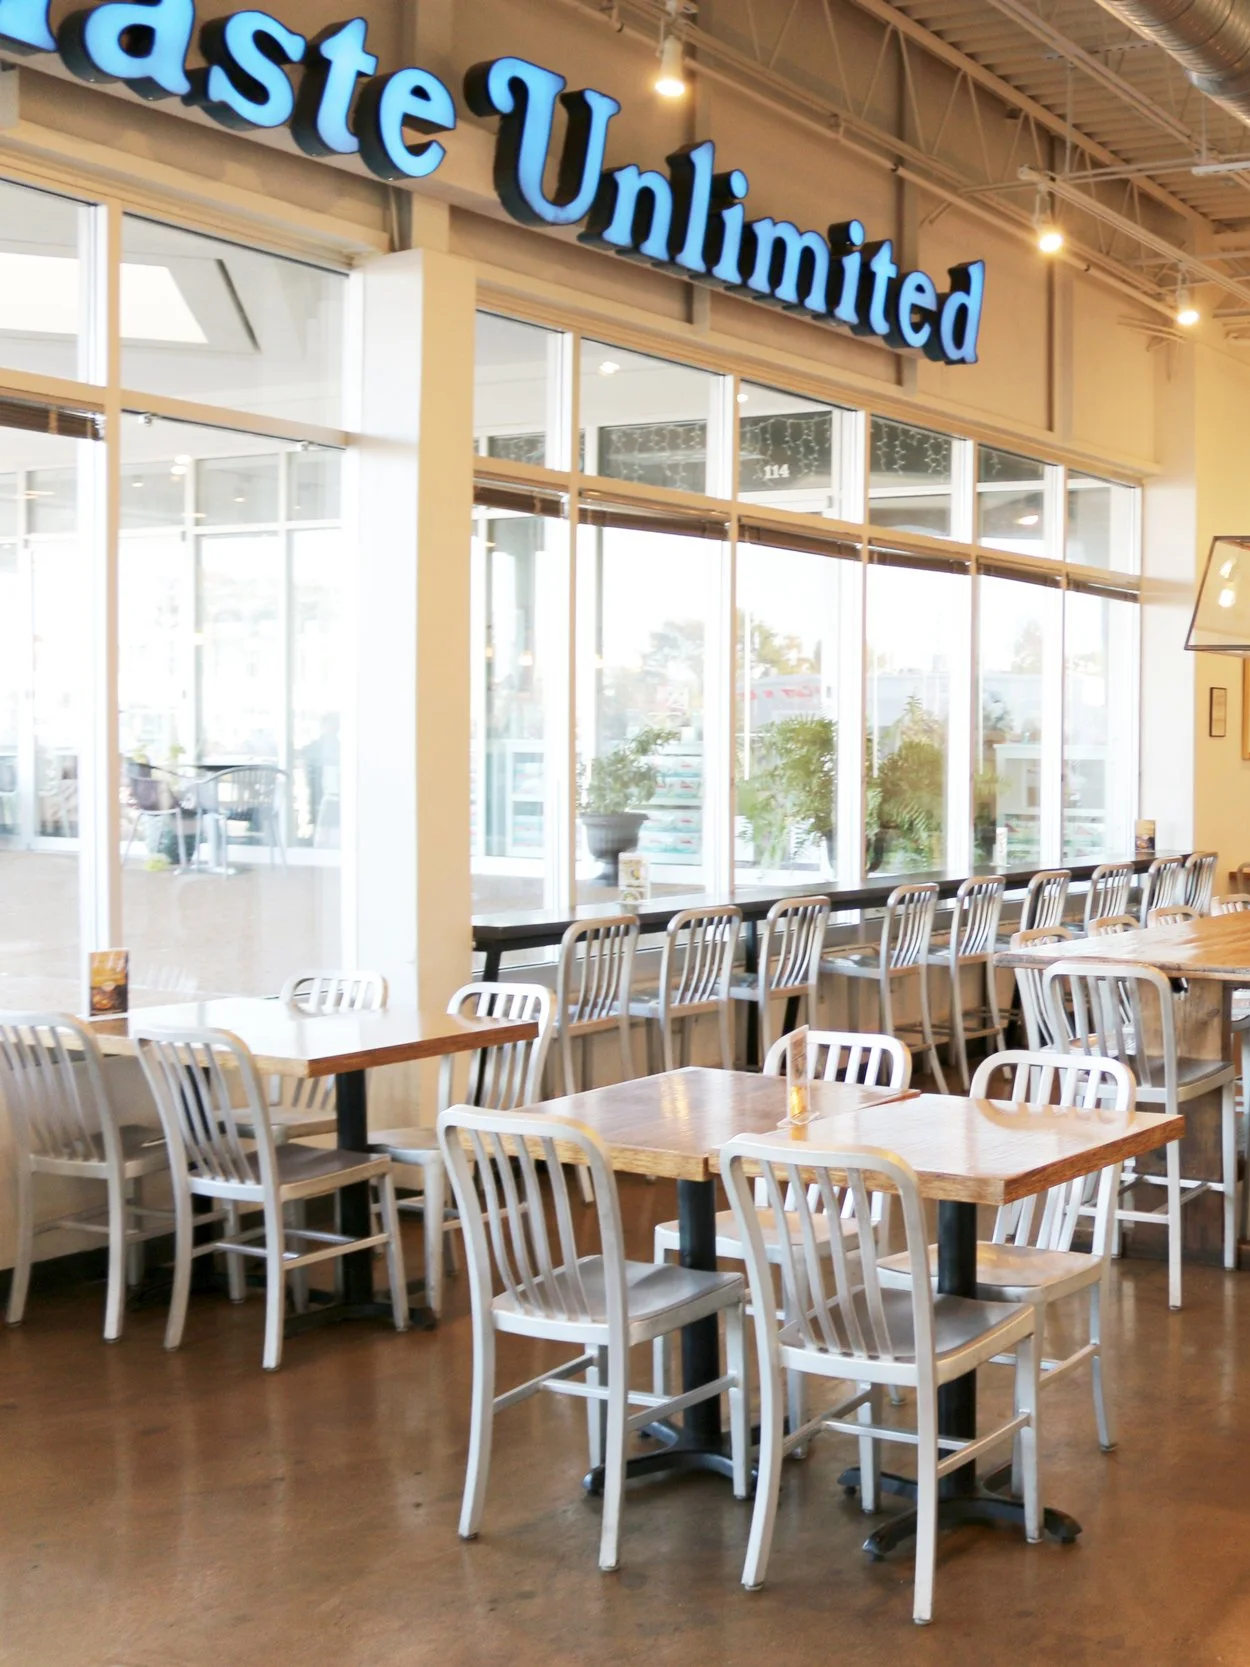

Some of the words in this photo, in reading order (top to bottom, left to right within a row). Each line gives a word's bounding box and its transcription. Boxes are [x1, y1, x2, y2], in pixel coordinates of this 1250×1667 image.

[0, 0, 457, 179] aste
[485, 55, 987, 366] Unlimited
[763, 464, 790, 479] 114
